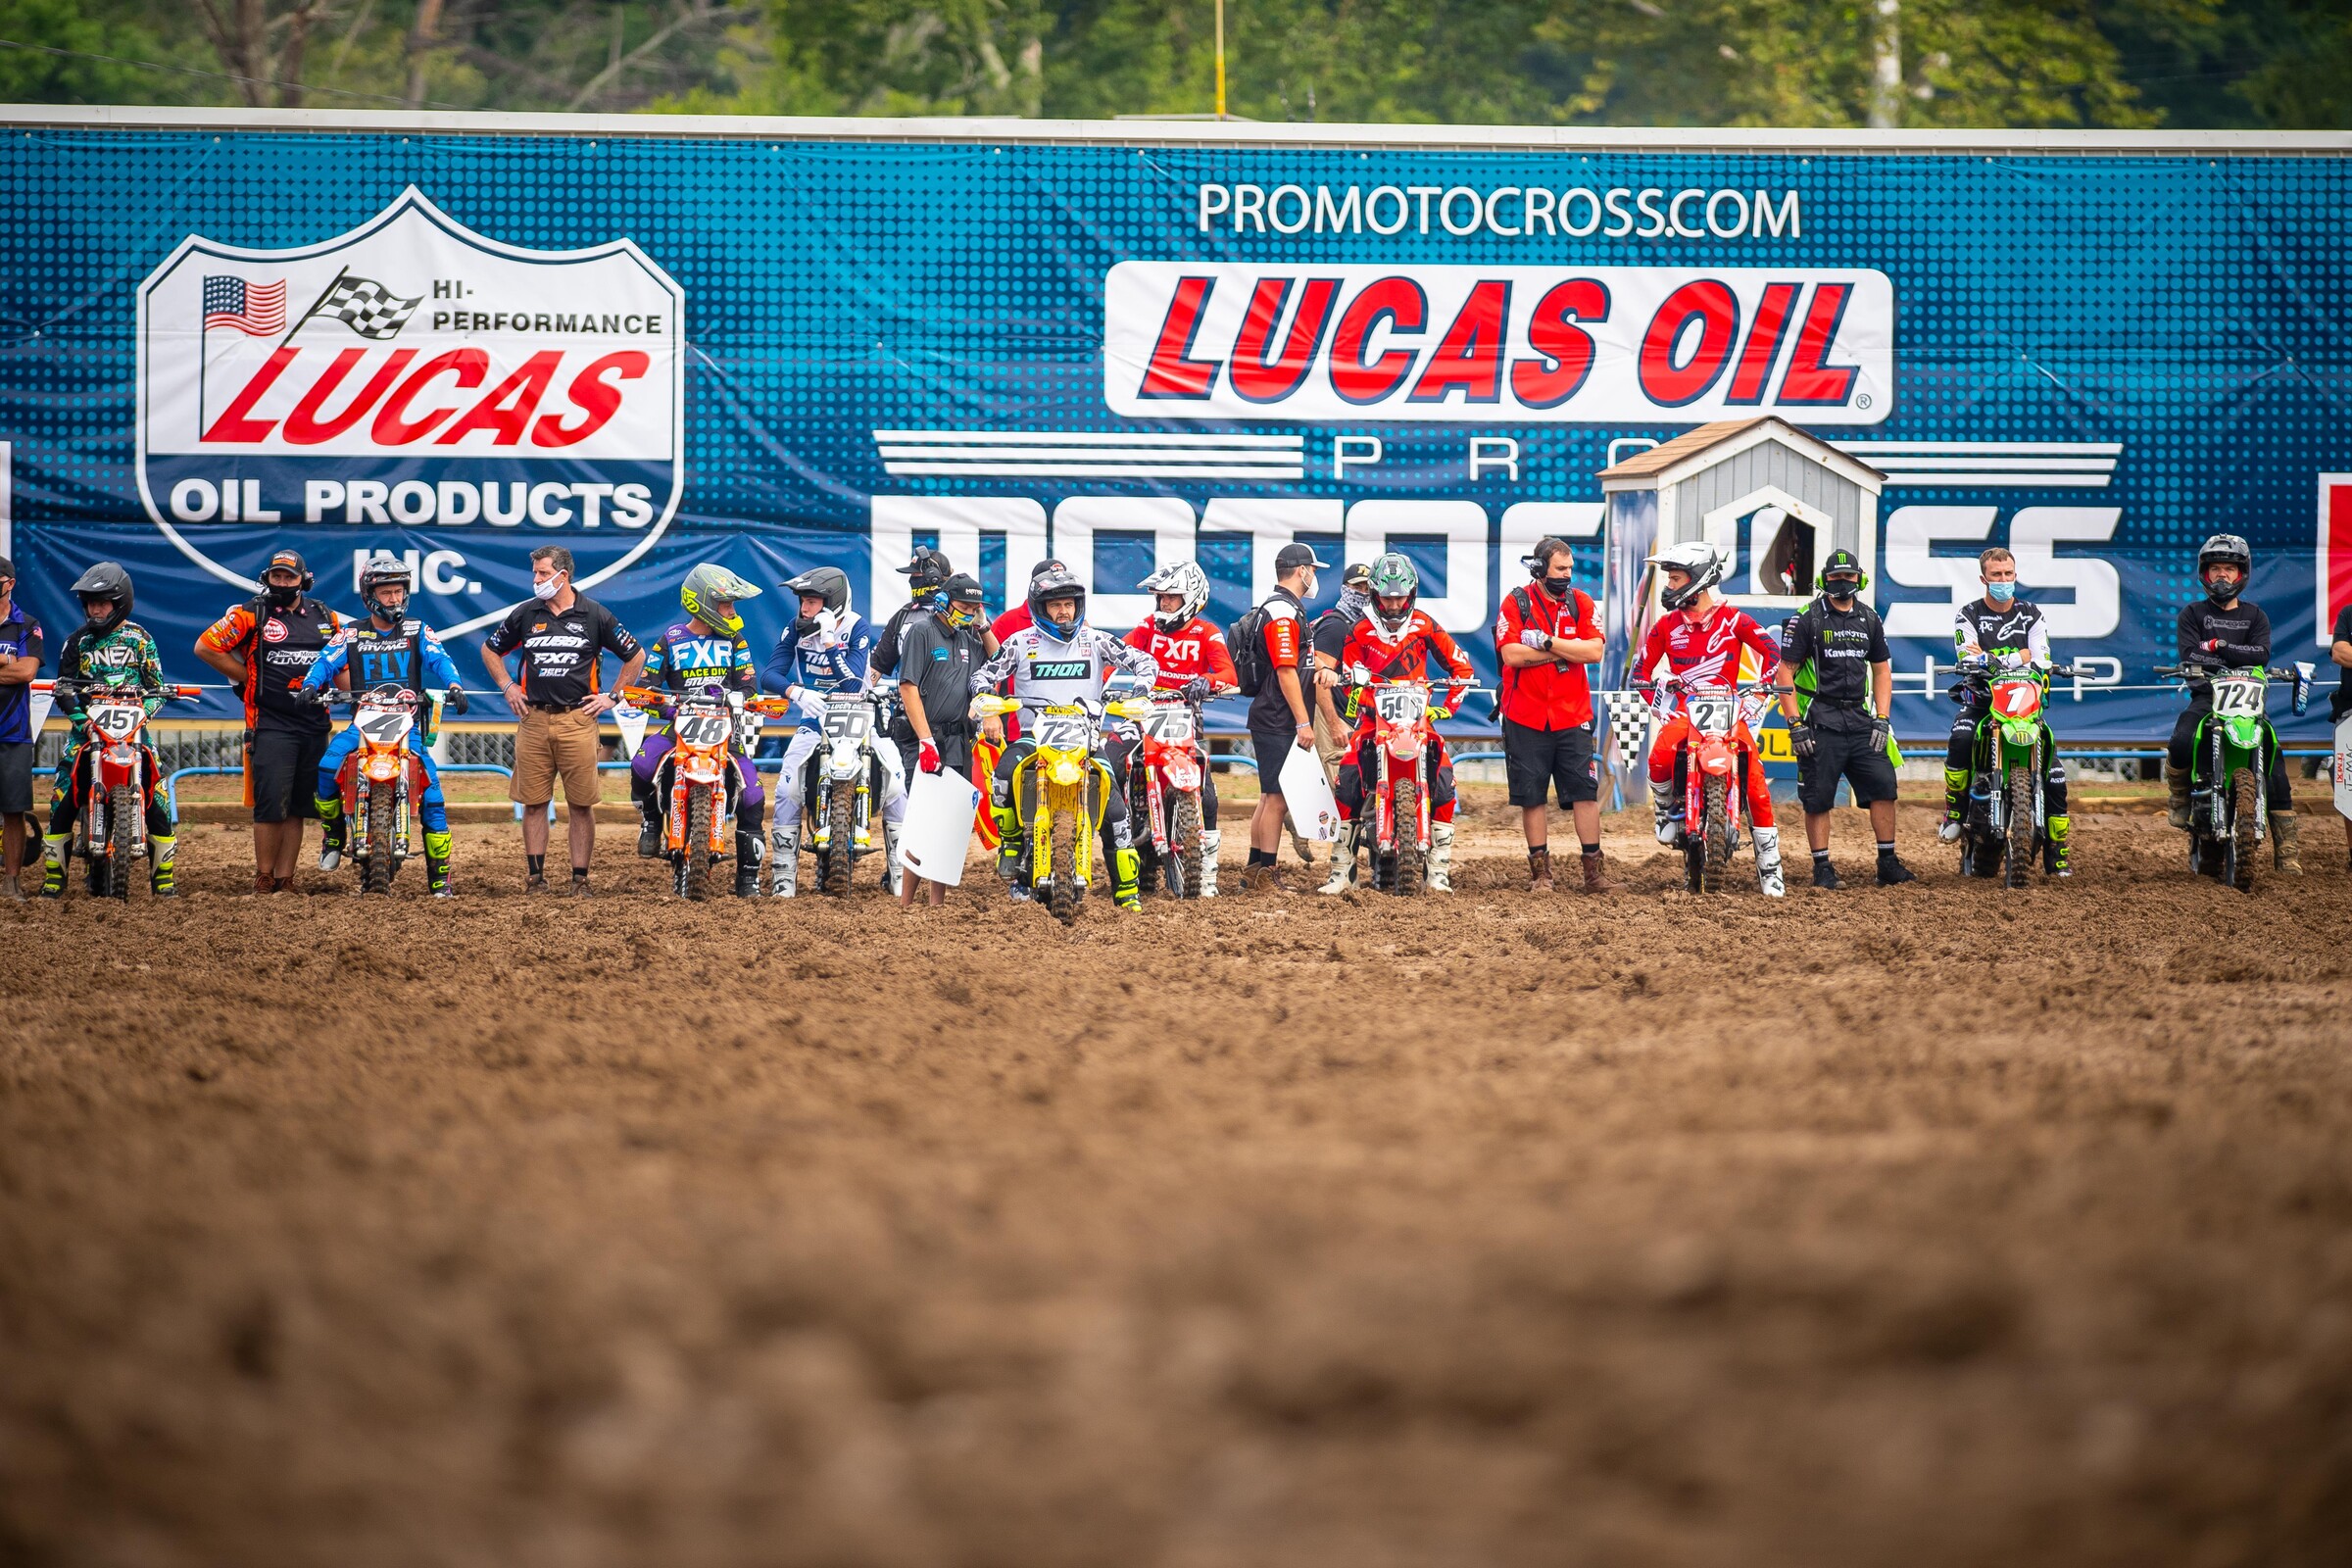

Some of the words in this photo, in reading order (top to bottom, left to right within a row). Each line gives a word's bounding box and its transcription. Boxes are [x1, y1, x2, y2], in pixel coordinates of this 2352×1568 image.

[1198, 182, 1801, 239] PROMOTOCROSS.COM
[432, 278, 474, 300] HI-
[432, 312, 662, 335] PERFORMANCE
[1137, 274, 1611, 411] LUCAS
[1638, 277, 1861, 408] OIL
[201, 347, 651, 447] LUCAS
[170, 477, 280, 523] OIL
[305, 479, 654, 531] PRODUCTS
[1834, 630, 1869, 640] MONSTER
[2214, 619, 2251, 628] RENEGADE
[532, 652, 580, 664] FXR
[671, 639, 733, 670] FXR
[1150, 633, 1200, 662] FXR
[362, 651, 411, 680] FLY
[682, 668, 710, 678] RACE
[1035, 662, 1086, 677] THOR
[1158, 669, 1200, 680] HONDA
[1347, 689, 1360, 716] 100%
[1381, 695, 1423, 721] 596
[2006, 687, 2028, 712] 1
[2217, 684, 2263, 710] 724
[2296, 679, 2310, 713] 100%
[94, 709, 140, 730] 451
[361, 713, 407, 741] 4
[680, 717, 726, 744] 48
[824, 711, 870, 738] 50
[1148, 711, 1190, 738] 75
[1694, 703, 1731, 731] 23
[1041, 720, 1090, 746] 722
[818, 789, 827, 825] DUOP
[1151, 797, 1162, 835] DUNLOP
